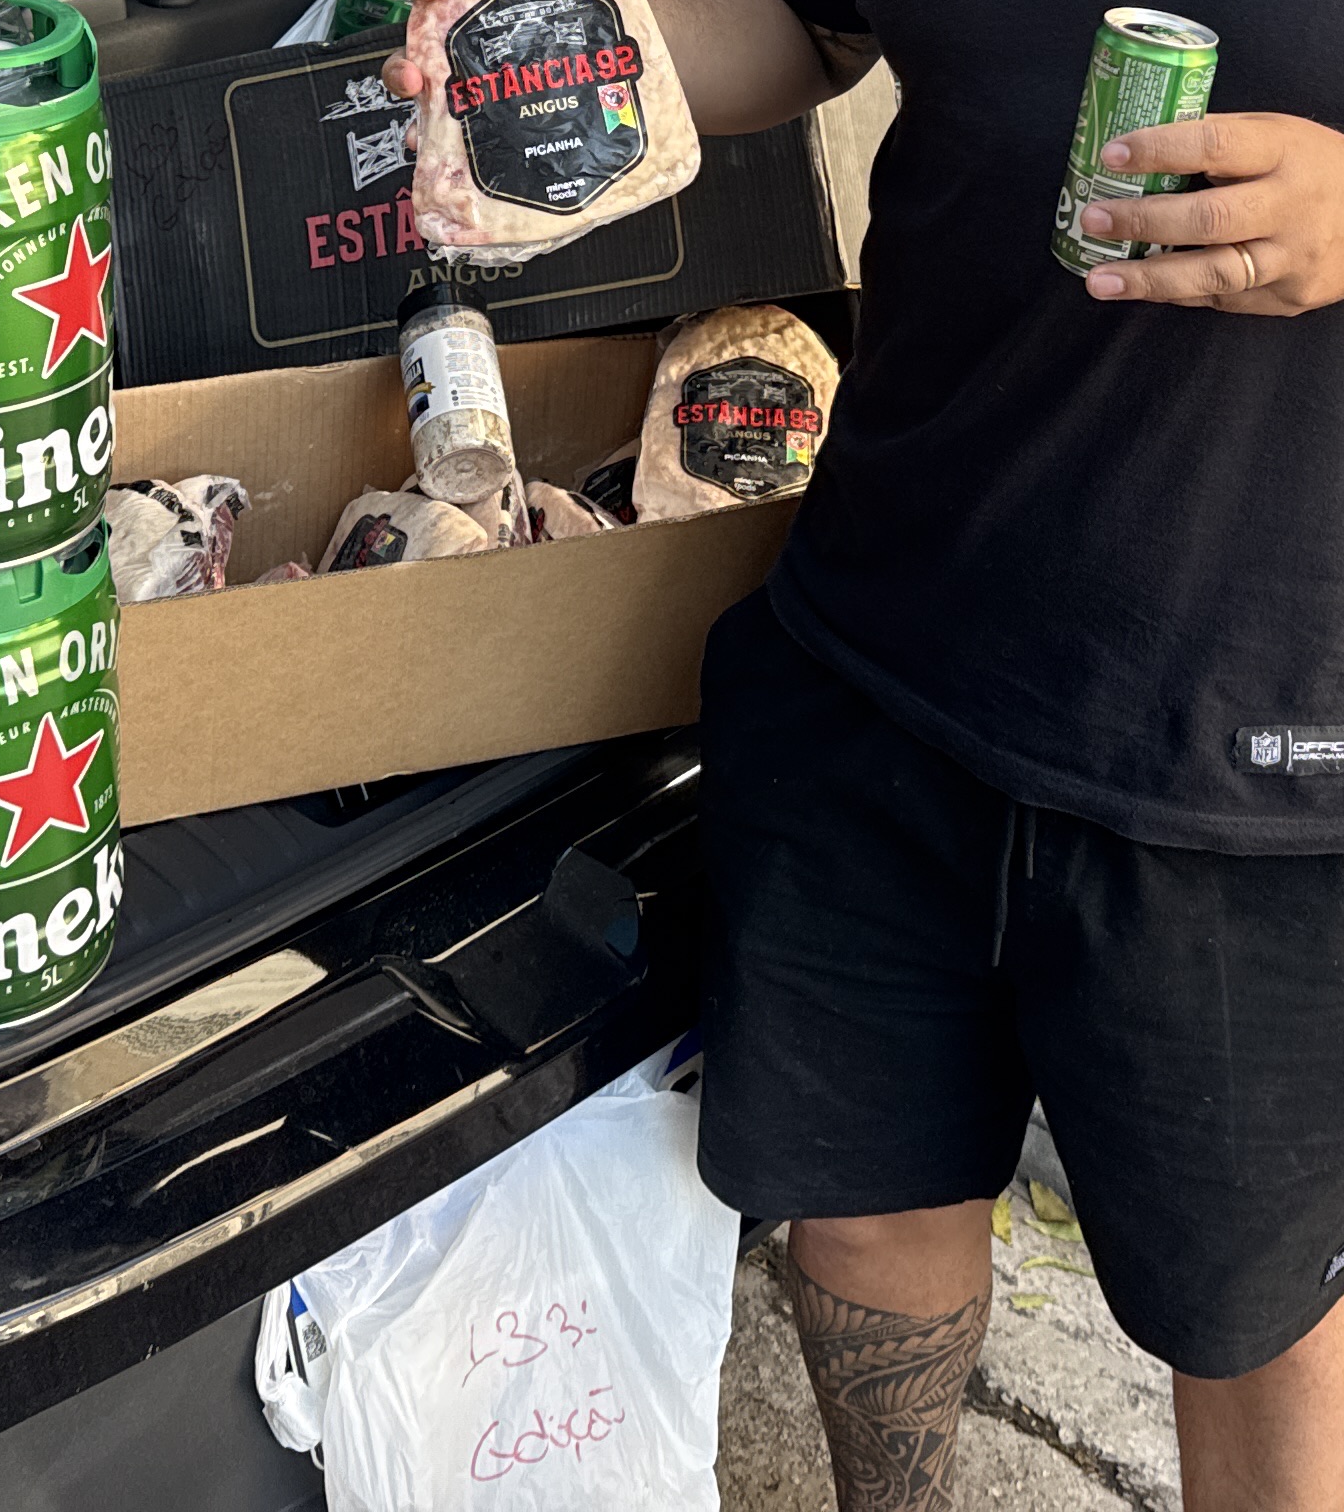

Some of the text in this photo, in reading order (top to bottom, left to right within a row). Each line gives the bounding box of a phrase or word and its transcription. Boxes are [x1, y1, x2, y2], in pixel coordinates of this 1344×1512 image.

[449, 51, 596, 114] ESTÂNCIA
[596, 45, 638, 80] 92
[518, 95, 579, 119] ANGUS
[524, 136, 584, 159] PICANHA
[548, 188, 578, 202] foods
[677, 400, 820, 432] ESTÂNCIA 92
[725, 430, 772, 441] ANGUS
[724, 454, 768, 464] PICANHA
[72, 486, 89, 514] 5L
[59, 618, 117, 683] ORI
[1255, 747, 1278, 761] NFL
[94, 783, 115, 816] 1873
[41, 965, 63, 992] 5L
